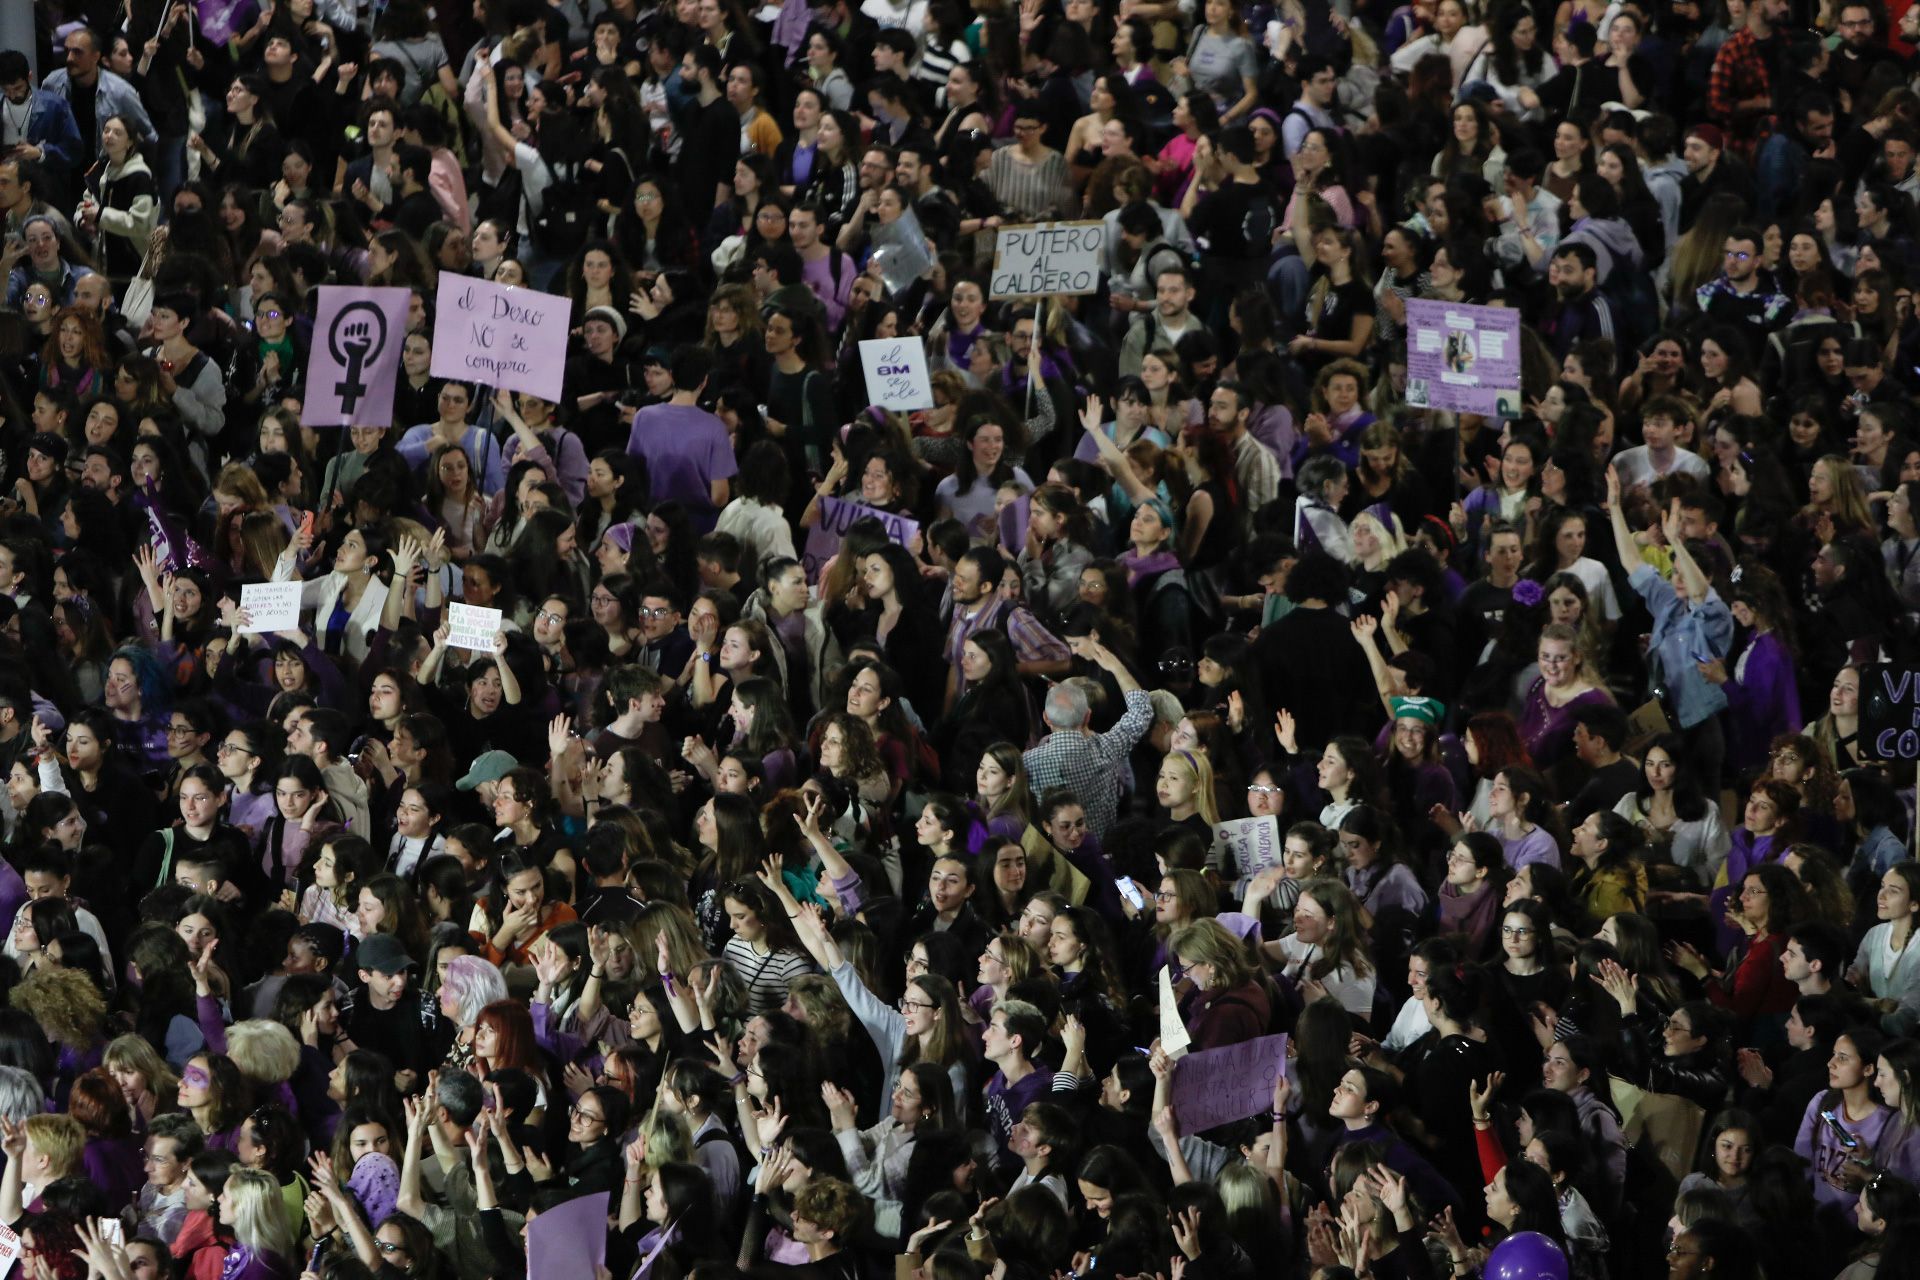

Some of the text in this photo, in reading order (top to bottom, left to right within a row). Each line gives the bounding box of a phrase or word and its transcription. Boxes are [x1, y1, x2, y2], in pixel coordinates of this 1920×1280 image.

[1006, 228, 1101, 256] PUTERO
[1030, 255, 1059, 273] AL
[993, 271, 1091, 294] CALDERO
[458, 286, 476, 311] el
[470, 321, 528, 351] NO se
[465, 355, 531, 378] compra
[881, 345, 902, 364] el
[877, 364, 910, 376] 8M
[820, 497, 904, 546] VUA
[1257, 821, 1274, 863] VIOLENCIA
